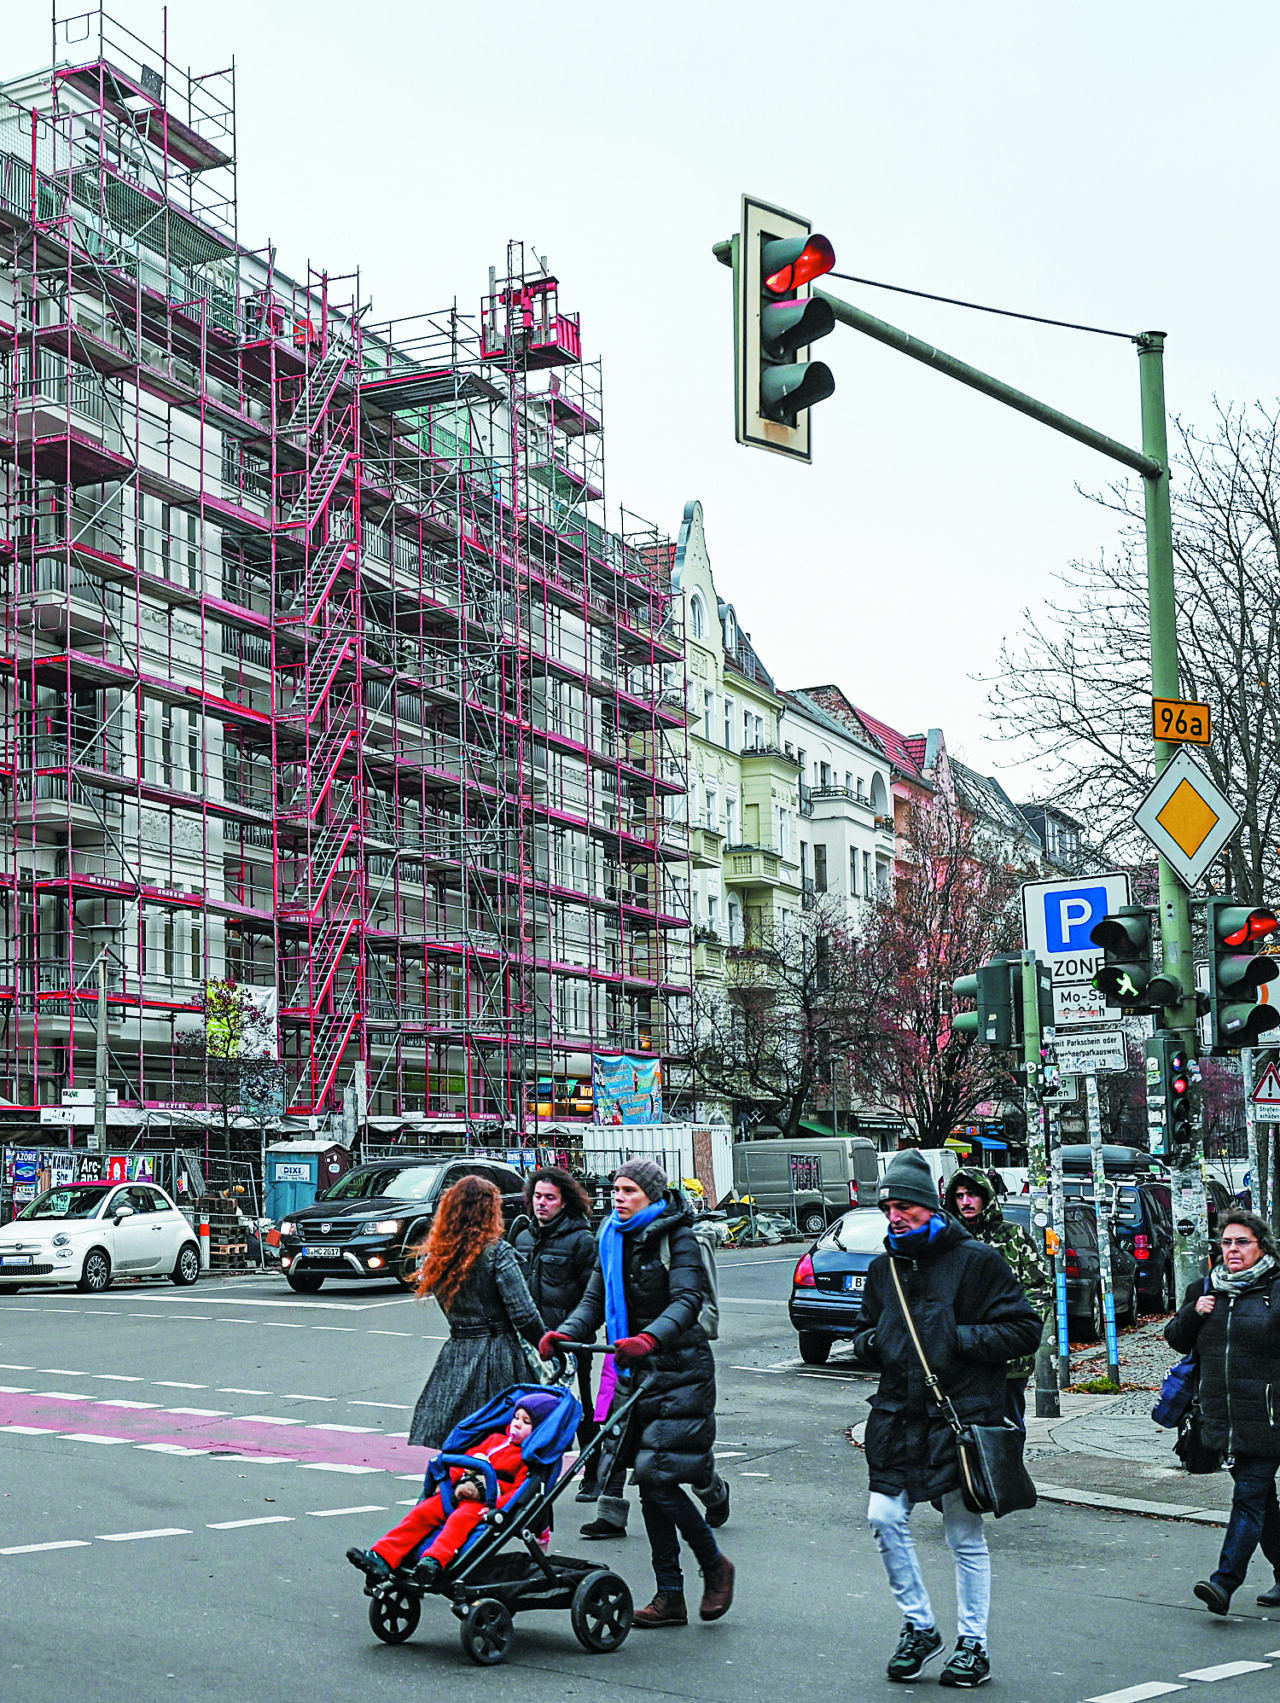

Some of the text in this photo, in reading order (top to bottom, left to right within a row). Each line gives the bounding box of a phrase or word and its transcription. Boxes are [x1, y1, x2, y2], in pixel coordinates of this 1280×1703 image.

[1160, 707, 1203, 737] 96a
[1059, 898, 1092, 944] P
[1061, 989, 1106, 1003] Mo-Sa
[1099, 1006, 1105, 1017] h
[1067, 1038, 1100, 1047] Parkschein
[1102, 1036, 1117, 1044] oder
[81, 1157, 101, 1173] Arc-
[56, 1171, 68, 1181] She
[855, 1278, 862, 1288] B
